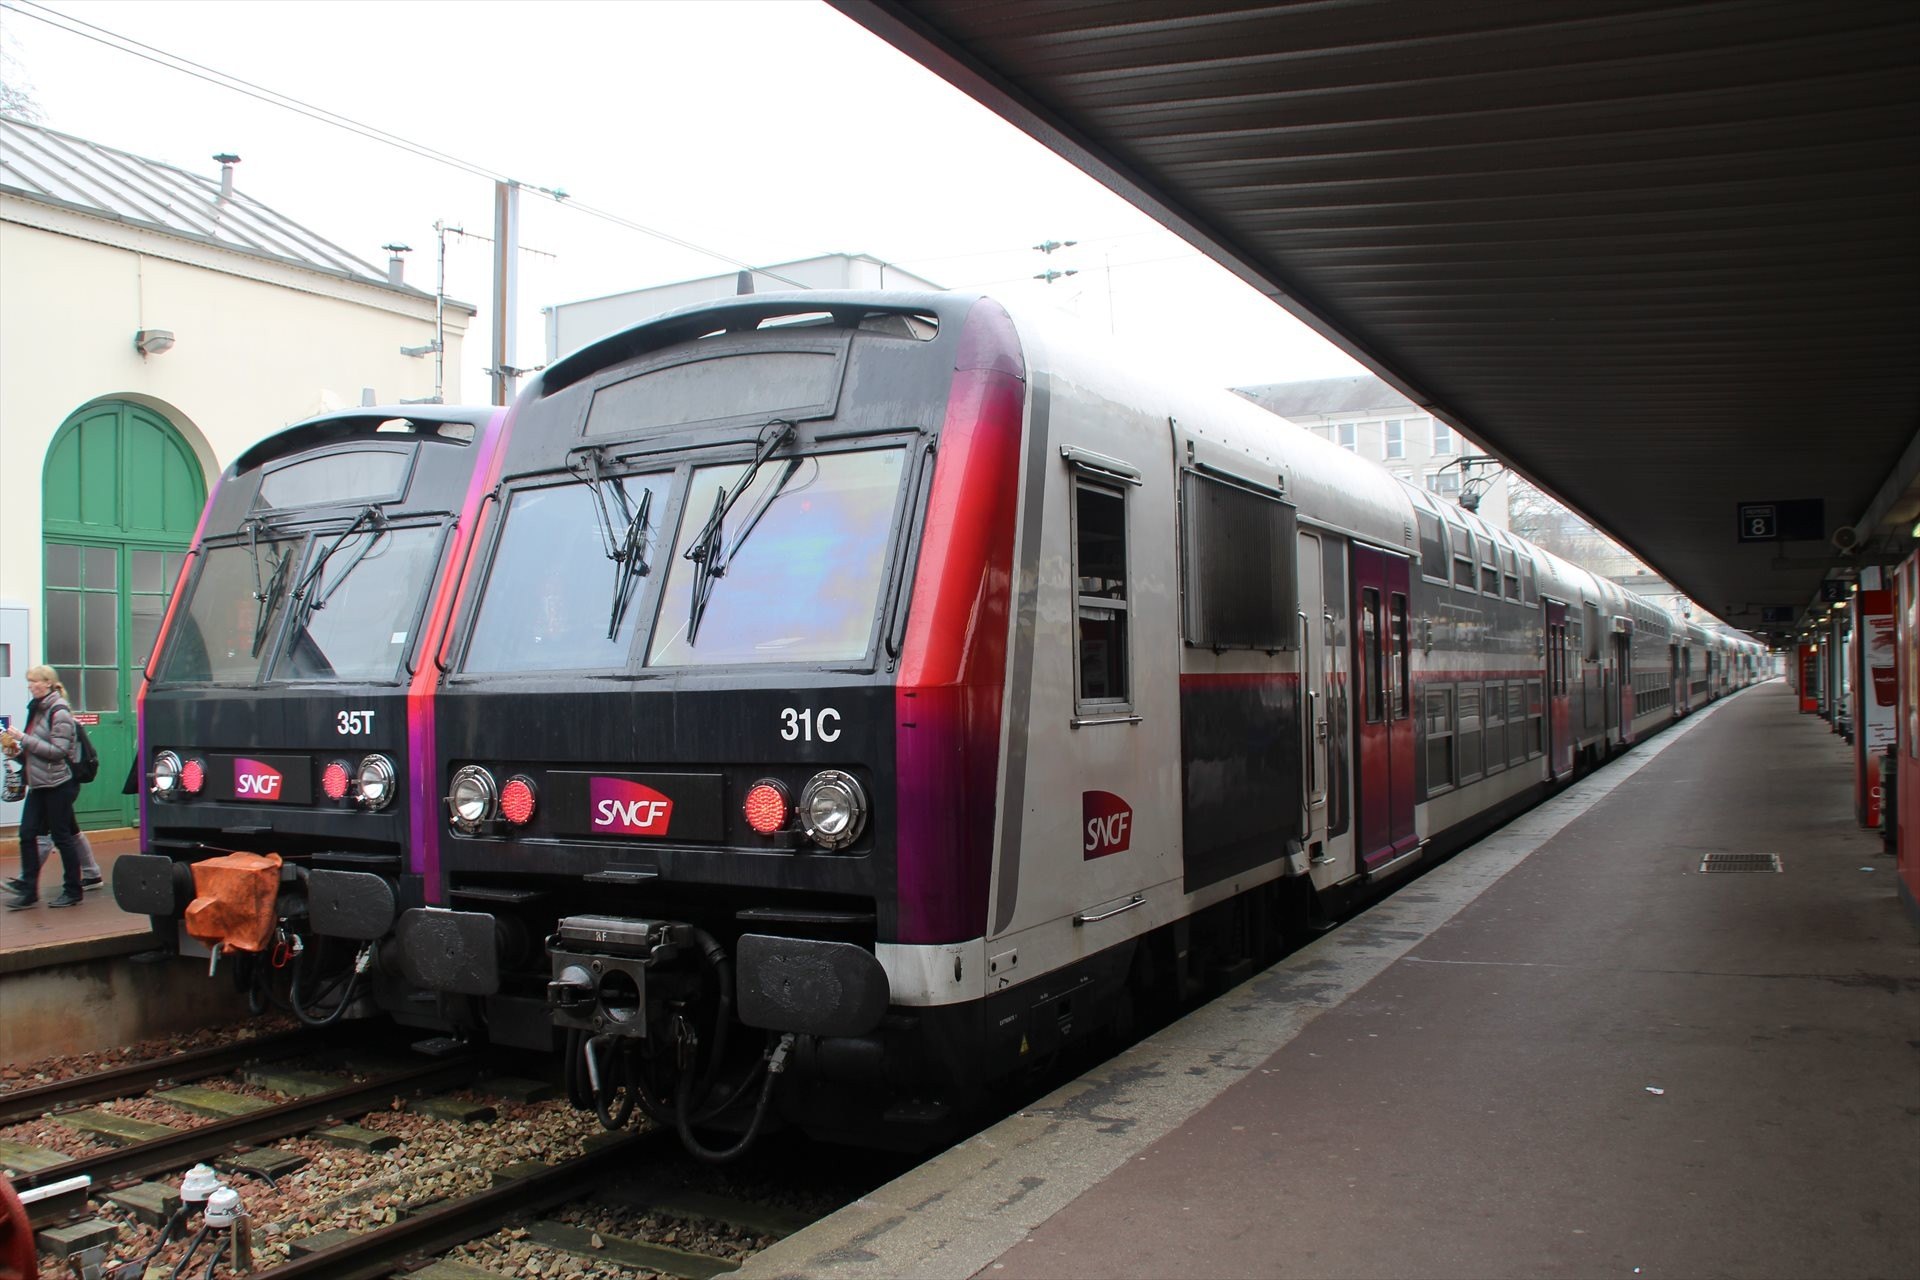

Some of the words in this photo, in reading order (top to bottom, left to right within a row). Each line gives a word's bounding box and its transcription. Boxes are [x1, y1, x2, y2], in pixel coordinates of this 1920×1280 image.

[1752, 518, 1765, 535] 8
[336, 710, 375, 736] 35T
[780, 707, 842, 743] 31C
[237, 774, 280, 793] SNCF
[594, 799, 669, 828] SNCF
[1085, 811, 1130, 852] SNCF
